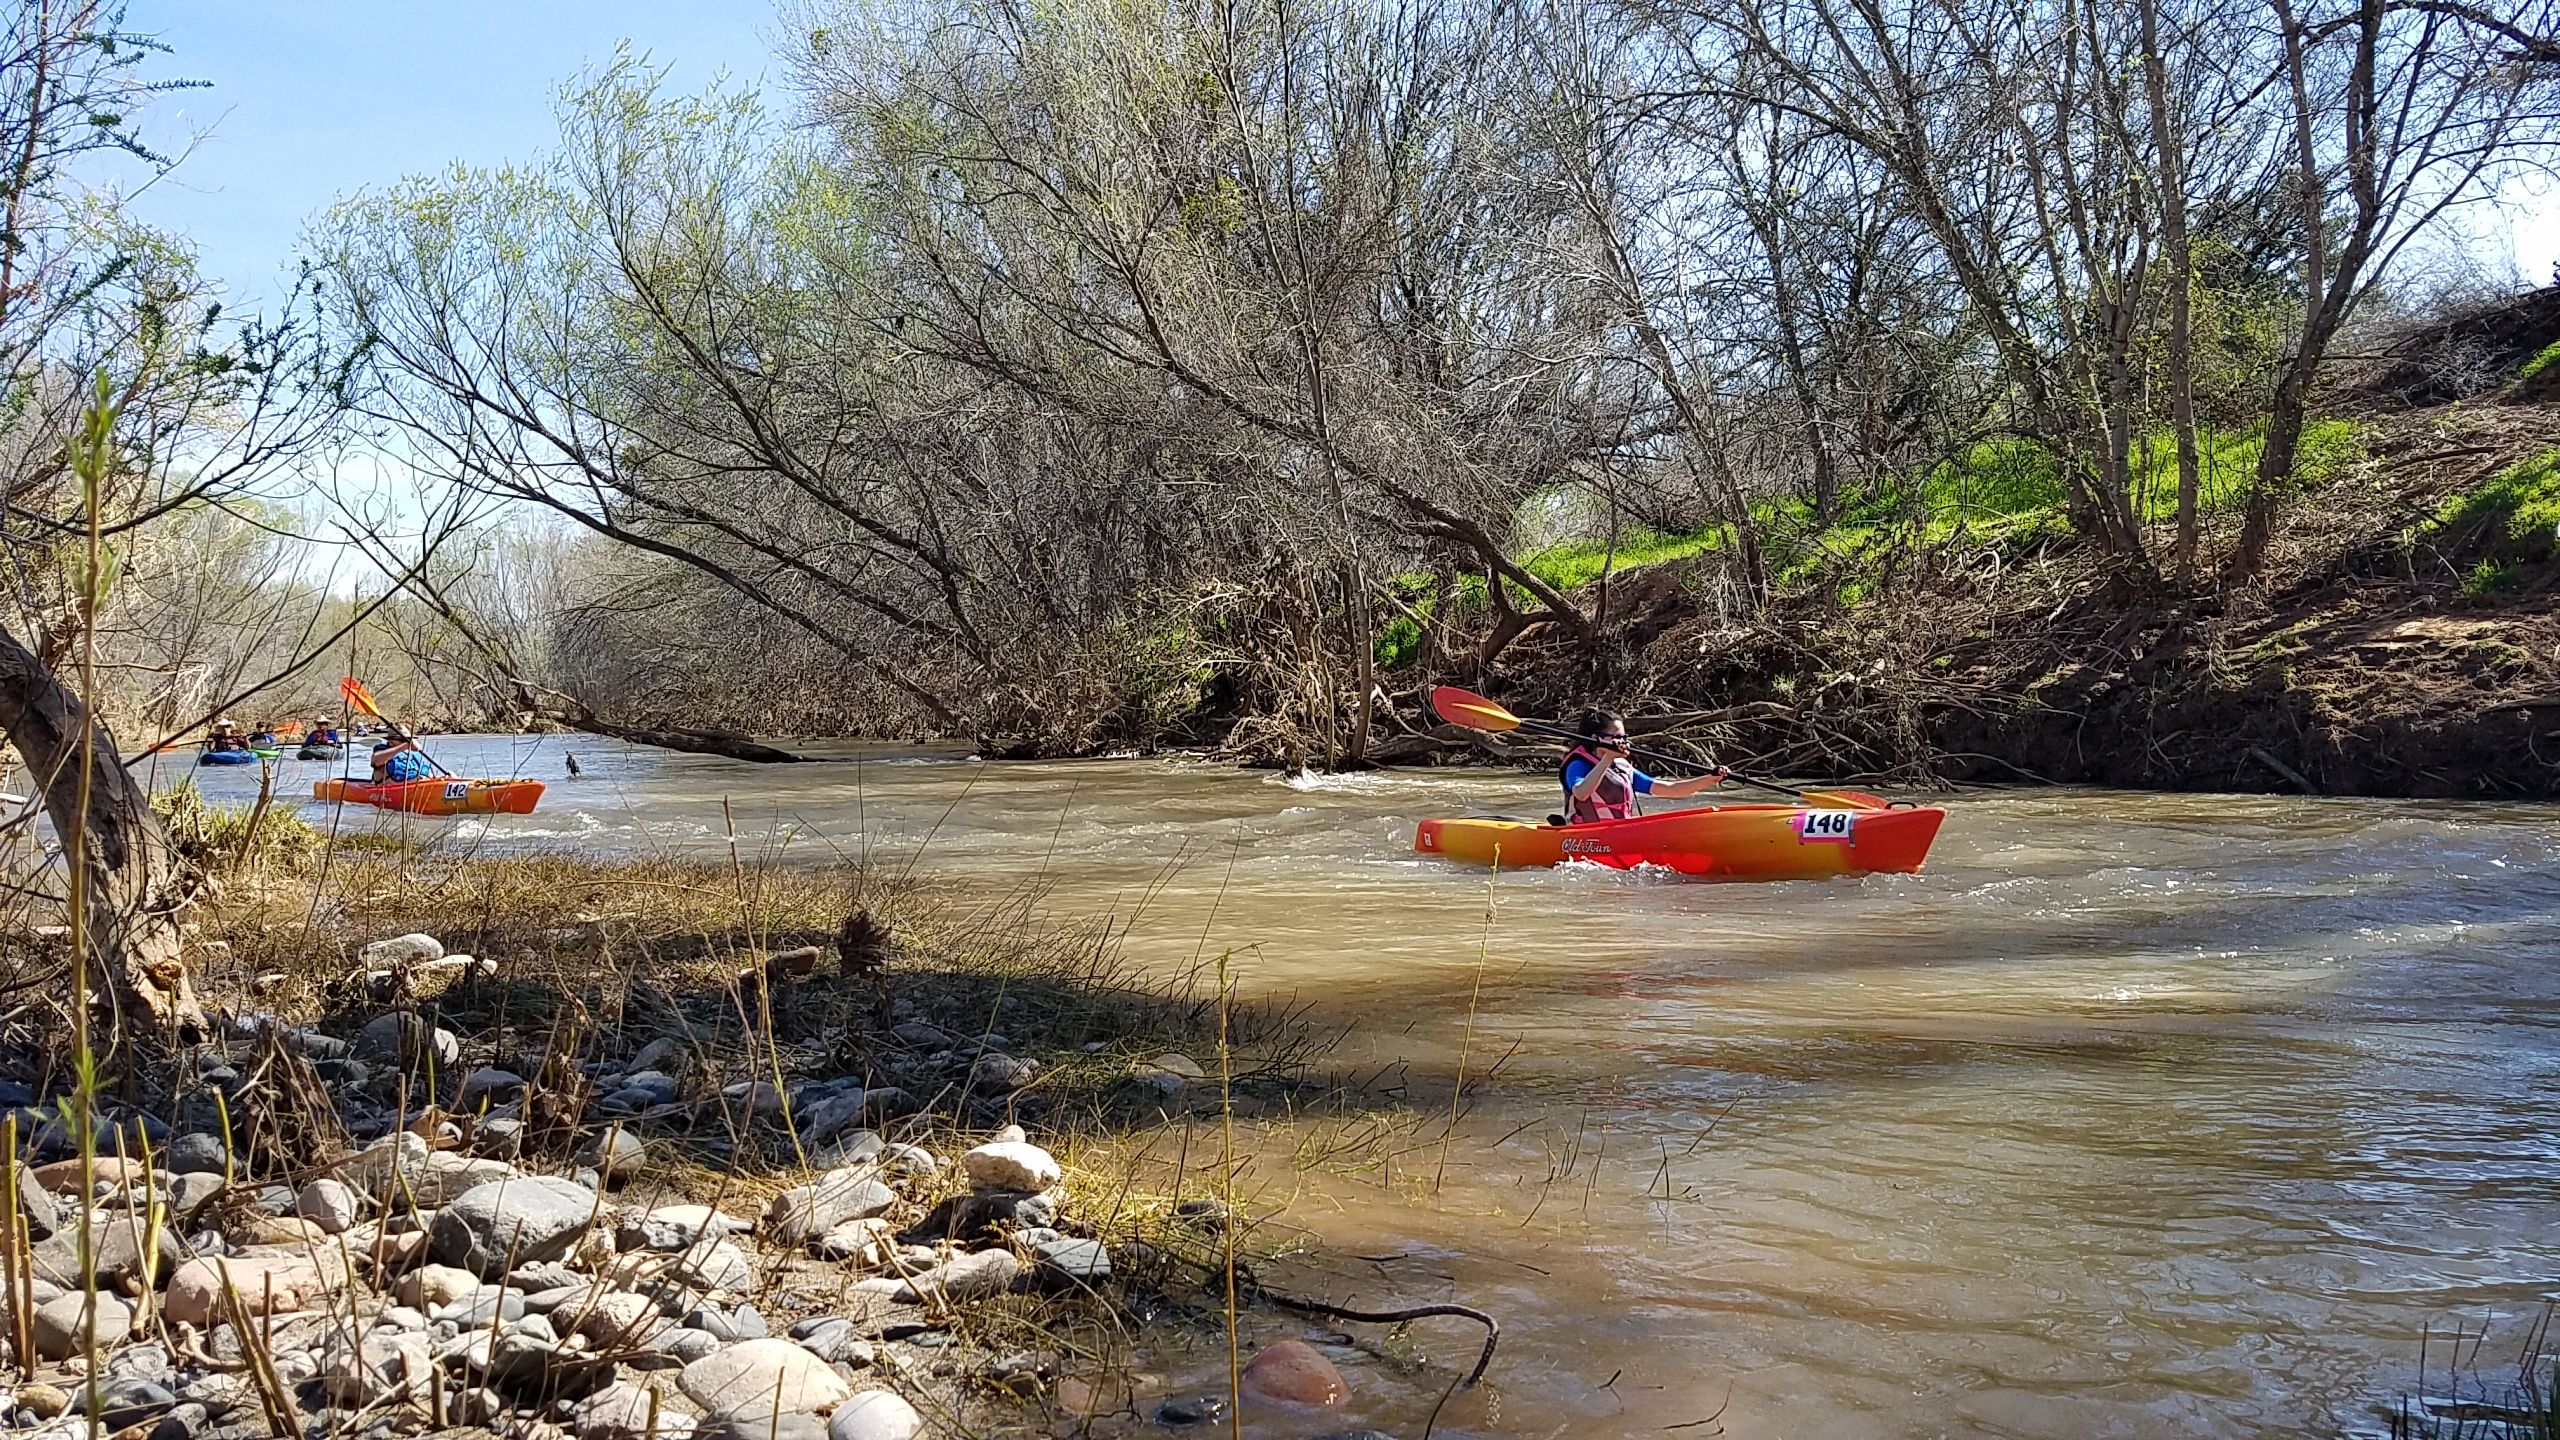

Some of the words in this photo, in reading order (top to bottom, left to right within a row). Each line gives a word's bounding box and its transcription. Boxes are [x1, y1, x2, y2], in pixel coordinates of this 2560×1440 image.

[447, 783, 466, 797] 142
[1805, 814, 1847, 834] 148
[1562, 838, 1582, 853] Old
